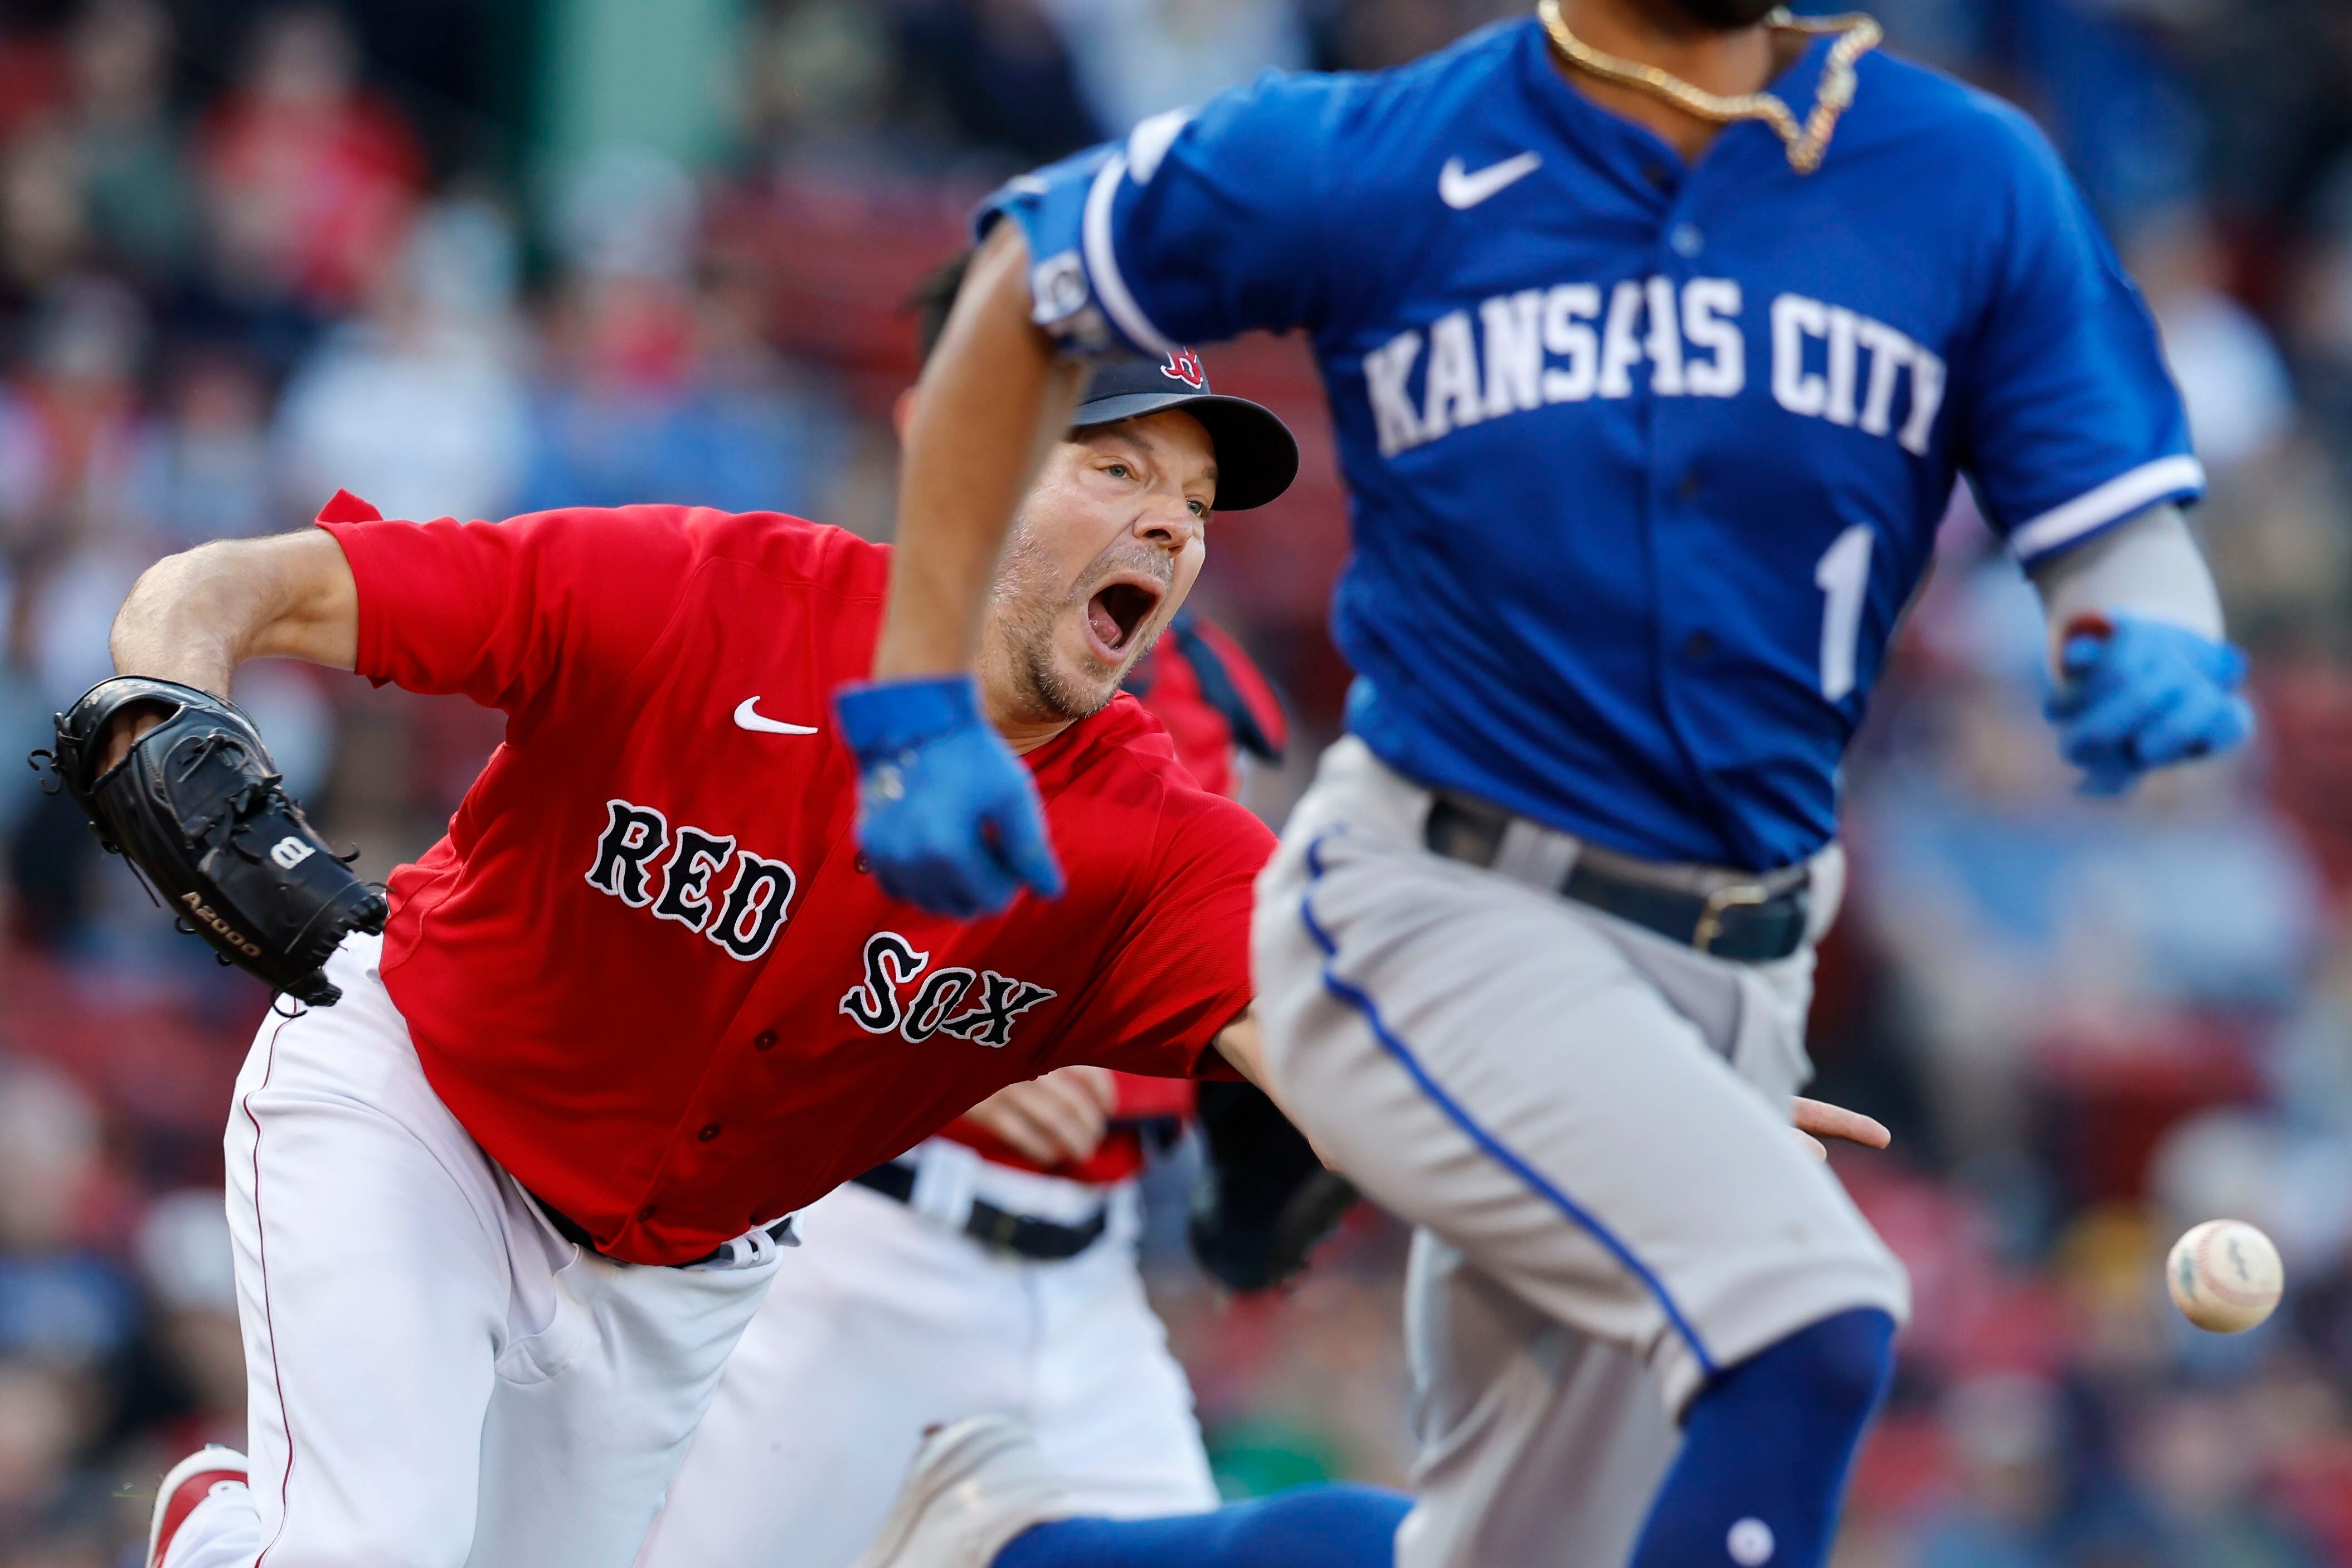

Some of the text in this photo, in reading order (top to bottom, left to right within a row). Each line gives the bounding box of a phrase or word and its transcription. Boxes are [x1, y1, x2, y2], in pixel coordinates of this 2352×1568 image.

[1363, 275, 1947, 458] KANSAS CITY
[1815, 523, 1874, 703] 1
[181, 892, 261, 957] A2000
[585, 799, 1057, 1048] RED SOX
